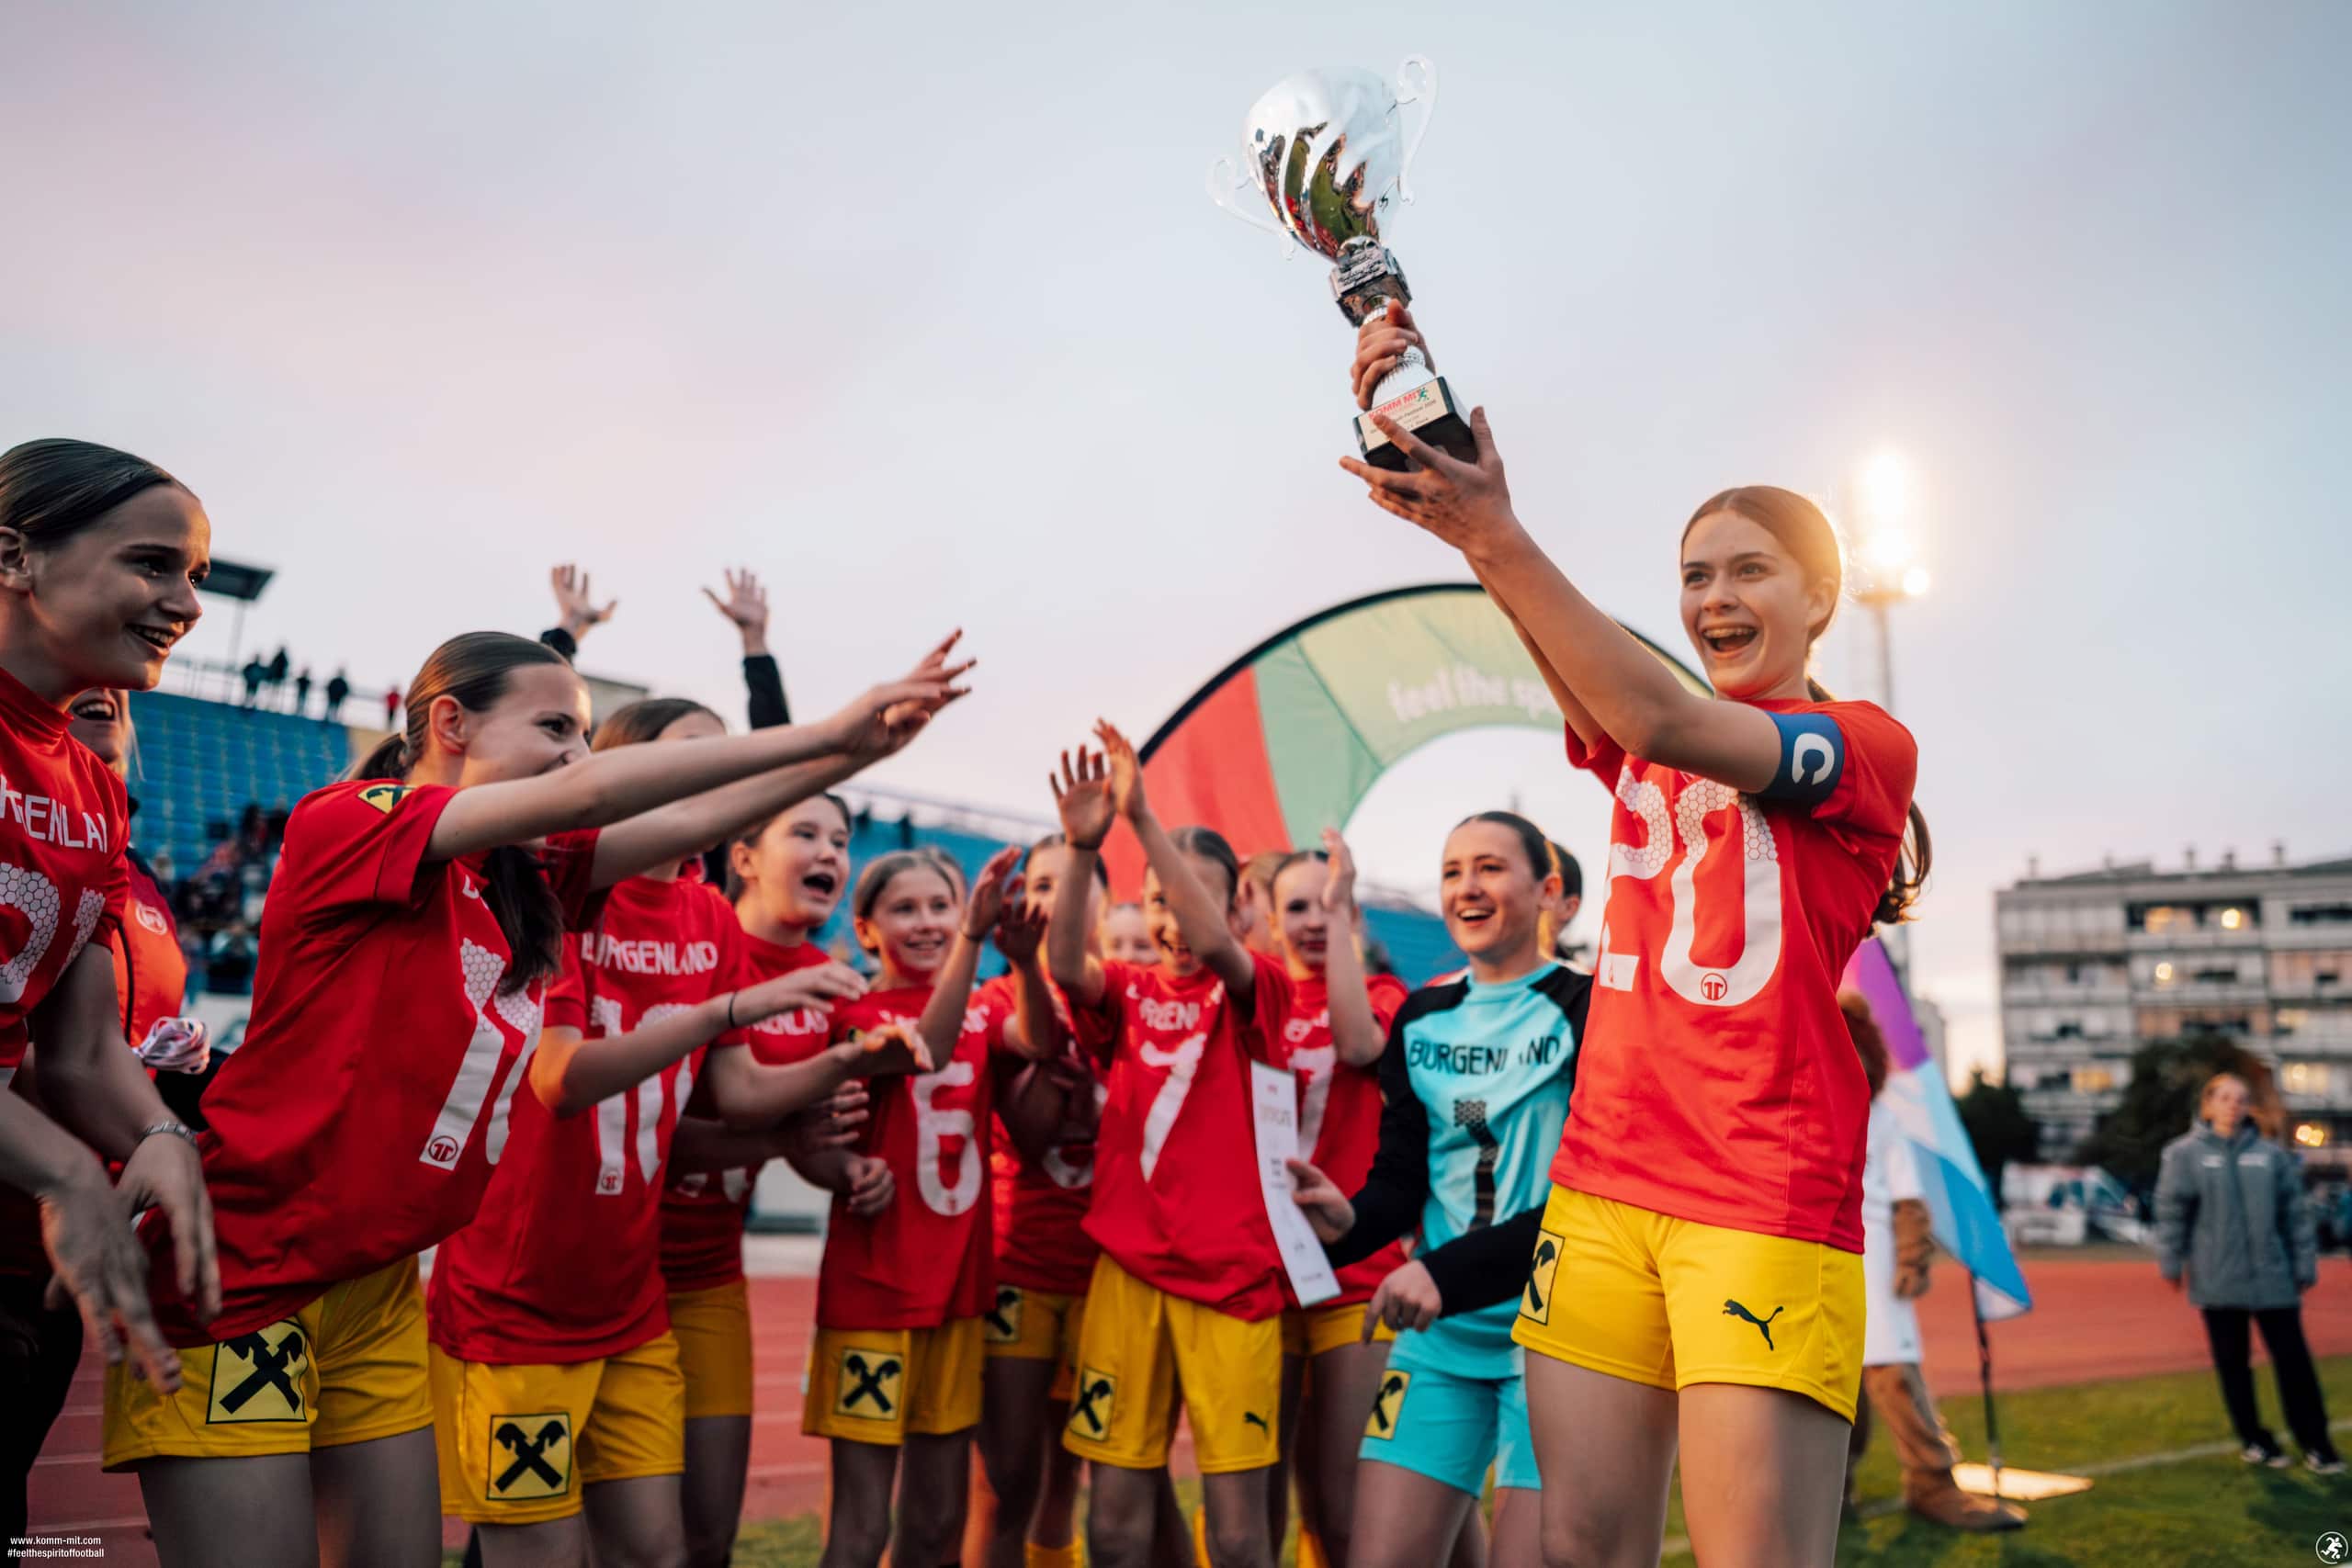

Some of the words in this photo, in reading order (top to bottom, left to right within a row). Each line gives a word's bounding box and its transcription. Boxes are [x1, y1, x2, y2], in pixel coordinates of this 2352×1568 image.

[1792, 732, 1836, 786] C
[1599, 764, 1781, 1007] 20
[590, 995, 695, 1196] 10
[1139, 1033, 1207, 1183] 7
[1408, 1035, 1561, 1076] BURGENND
[912, 1060, 982, 1216] 6
